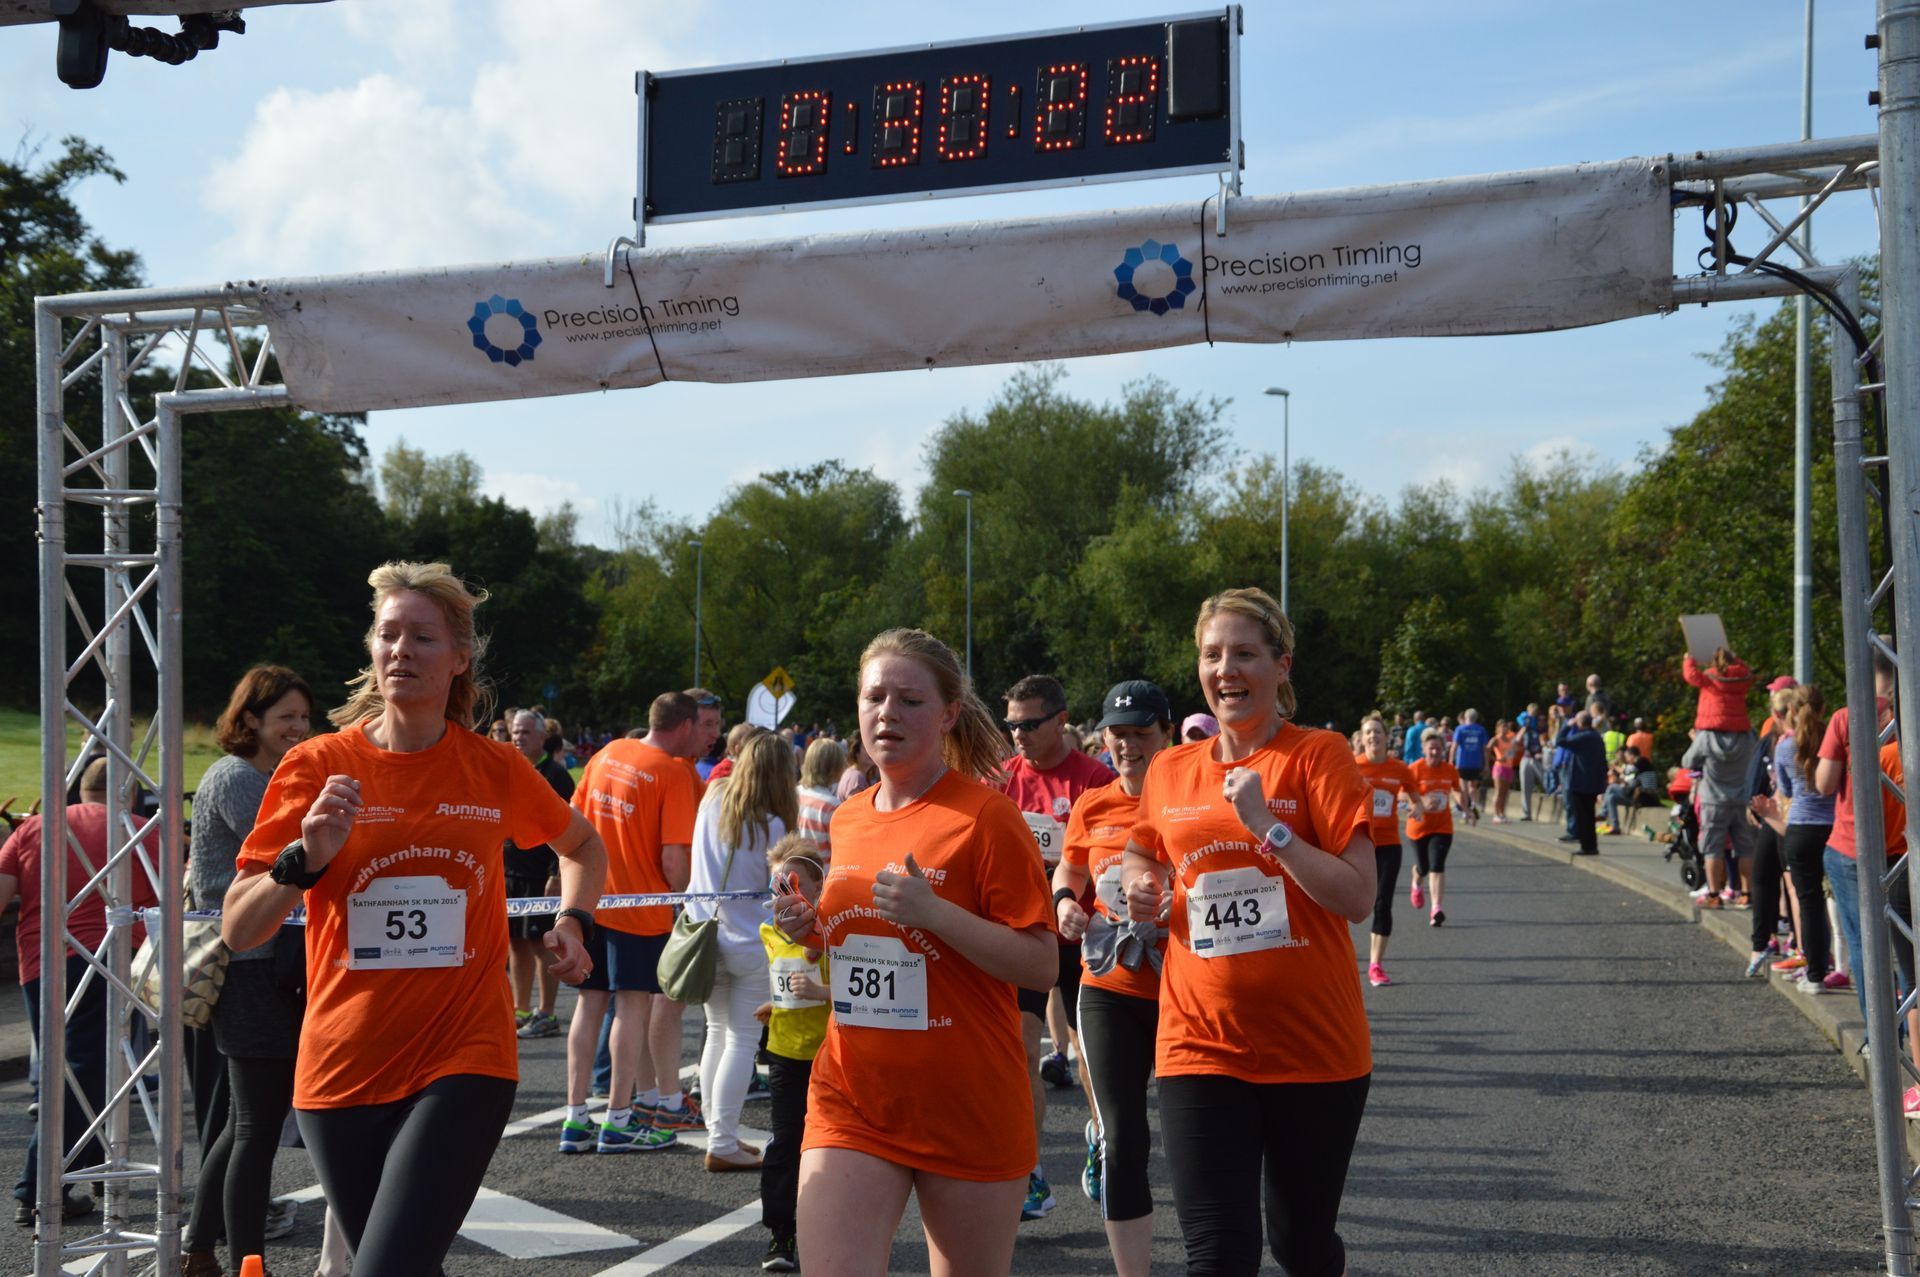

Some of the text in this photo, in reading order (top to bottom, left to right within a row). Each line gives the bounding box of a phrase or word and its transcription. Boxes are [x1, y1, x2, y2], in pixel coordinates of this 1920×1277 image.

[1203, 241, 1421, 278] Precision Timing
[1221, 270, 1399, 296] www.precisiontiming.net
[544, 294, 740, 330] Precision Timing
[566, 318, 722, 344] www.precisiontiming.net
[353, 898, 410, 908] RATHFARNHAM
[1244, 887, 1259, 895] RUN
[1260, 885, 1277, 893] 2015
[385, 909, 428, 940] 53
[1204, 898, 1261, 931] 443
[833, 954, 877, 965] RATHFARNHAM
[848, 967, 895, 1001] 581
